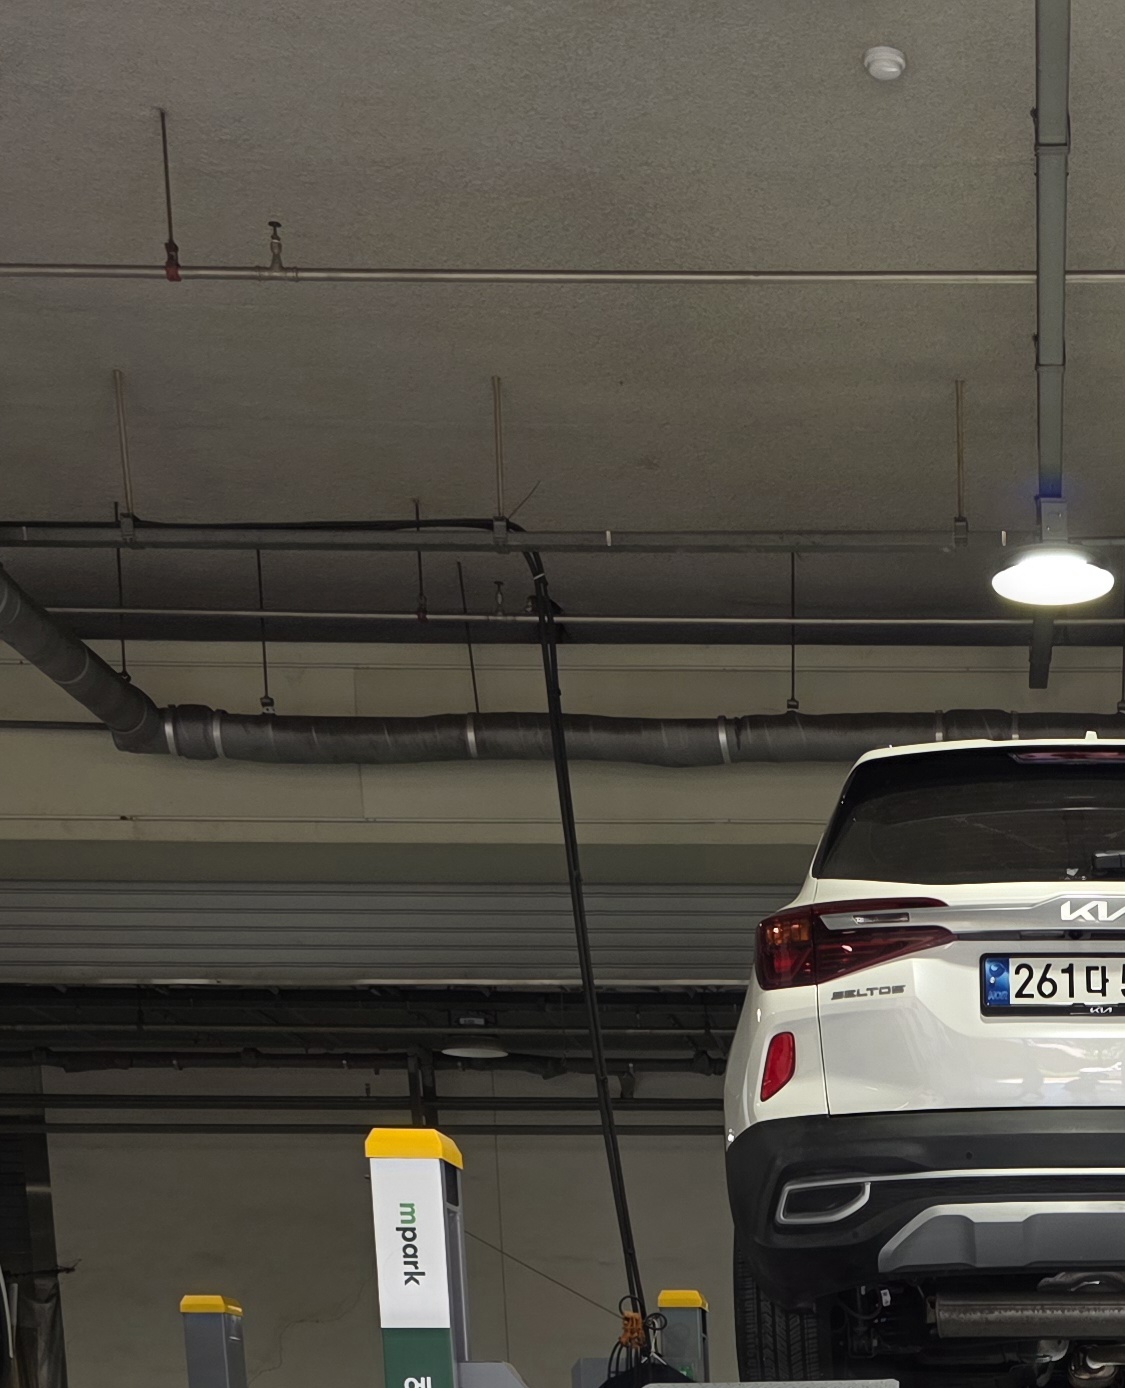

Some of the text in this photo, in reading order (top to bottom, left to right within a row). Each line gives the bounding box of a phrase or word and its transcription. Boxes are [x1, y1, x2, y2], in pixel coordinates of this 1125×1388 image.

[831, 985, 906, 1000] SELTOS
[1014, 963, 1110, 999] 261다
[396, 1203, 426, 1286] mpark
